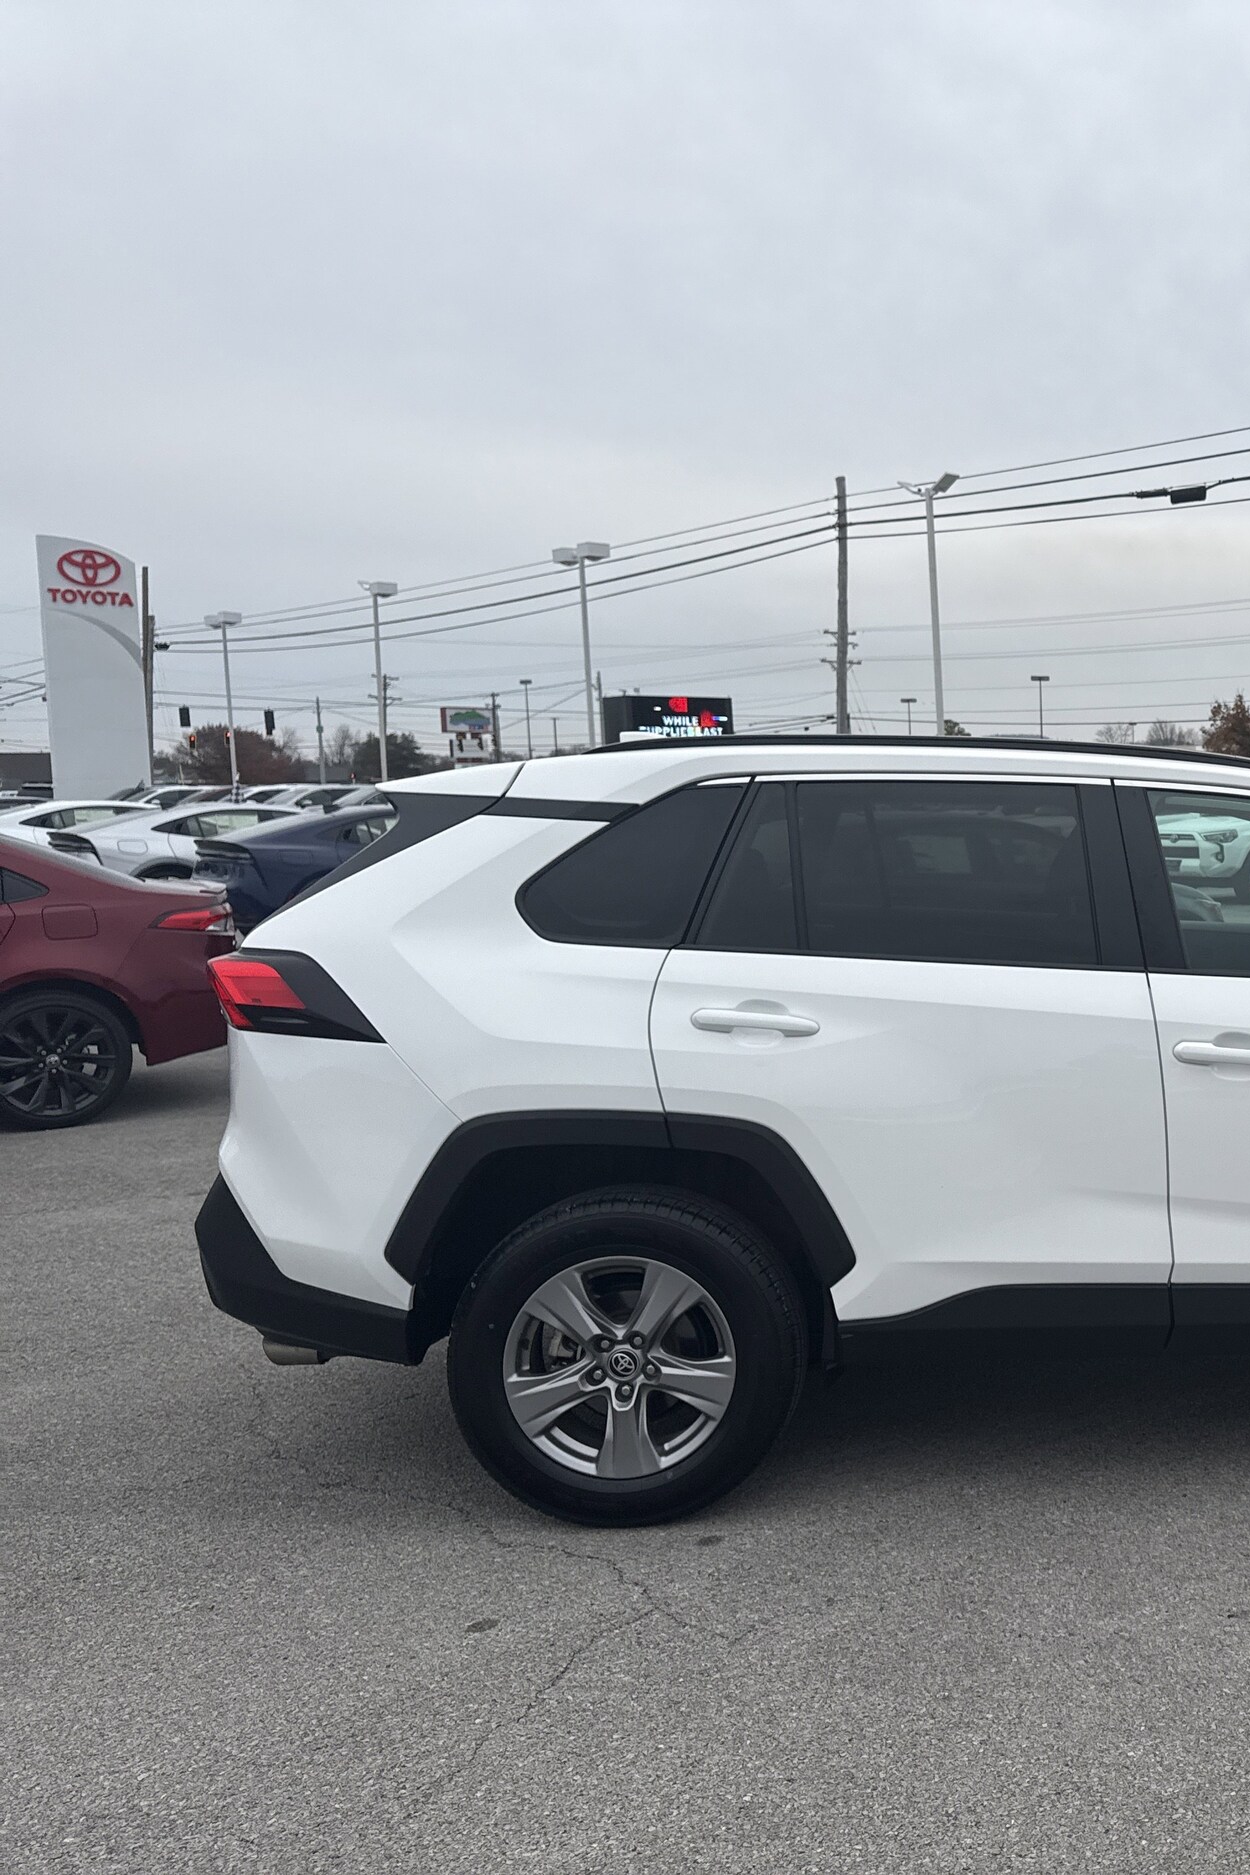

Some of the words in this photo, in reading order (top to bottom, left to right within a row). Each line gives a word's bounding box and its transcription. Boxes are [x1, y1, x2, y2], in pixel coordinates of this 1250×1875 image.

[47, 588, 134, 607] TOYOTA
[662, 715, 699, 726] WHILE
[695, 727, 723, 736] LAST
